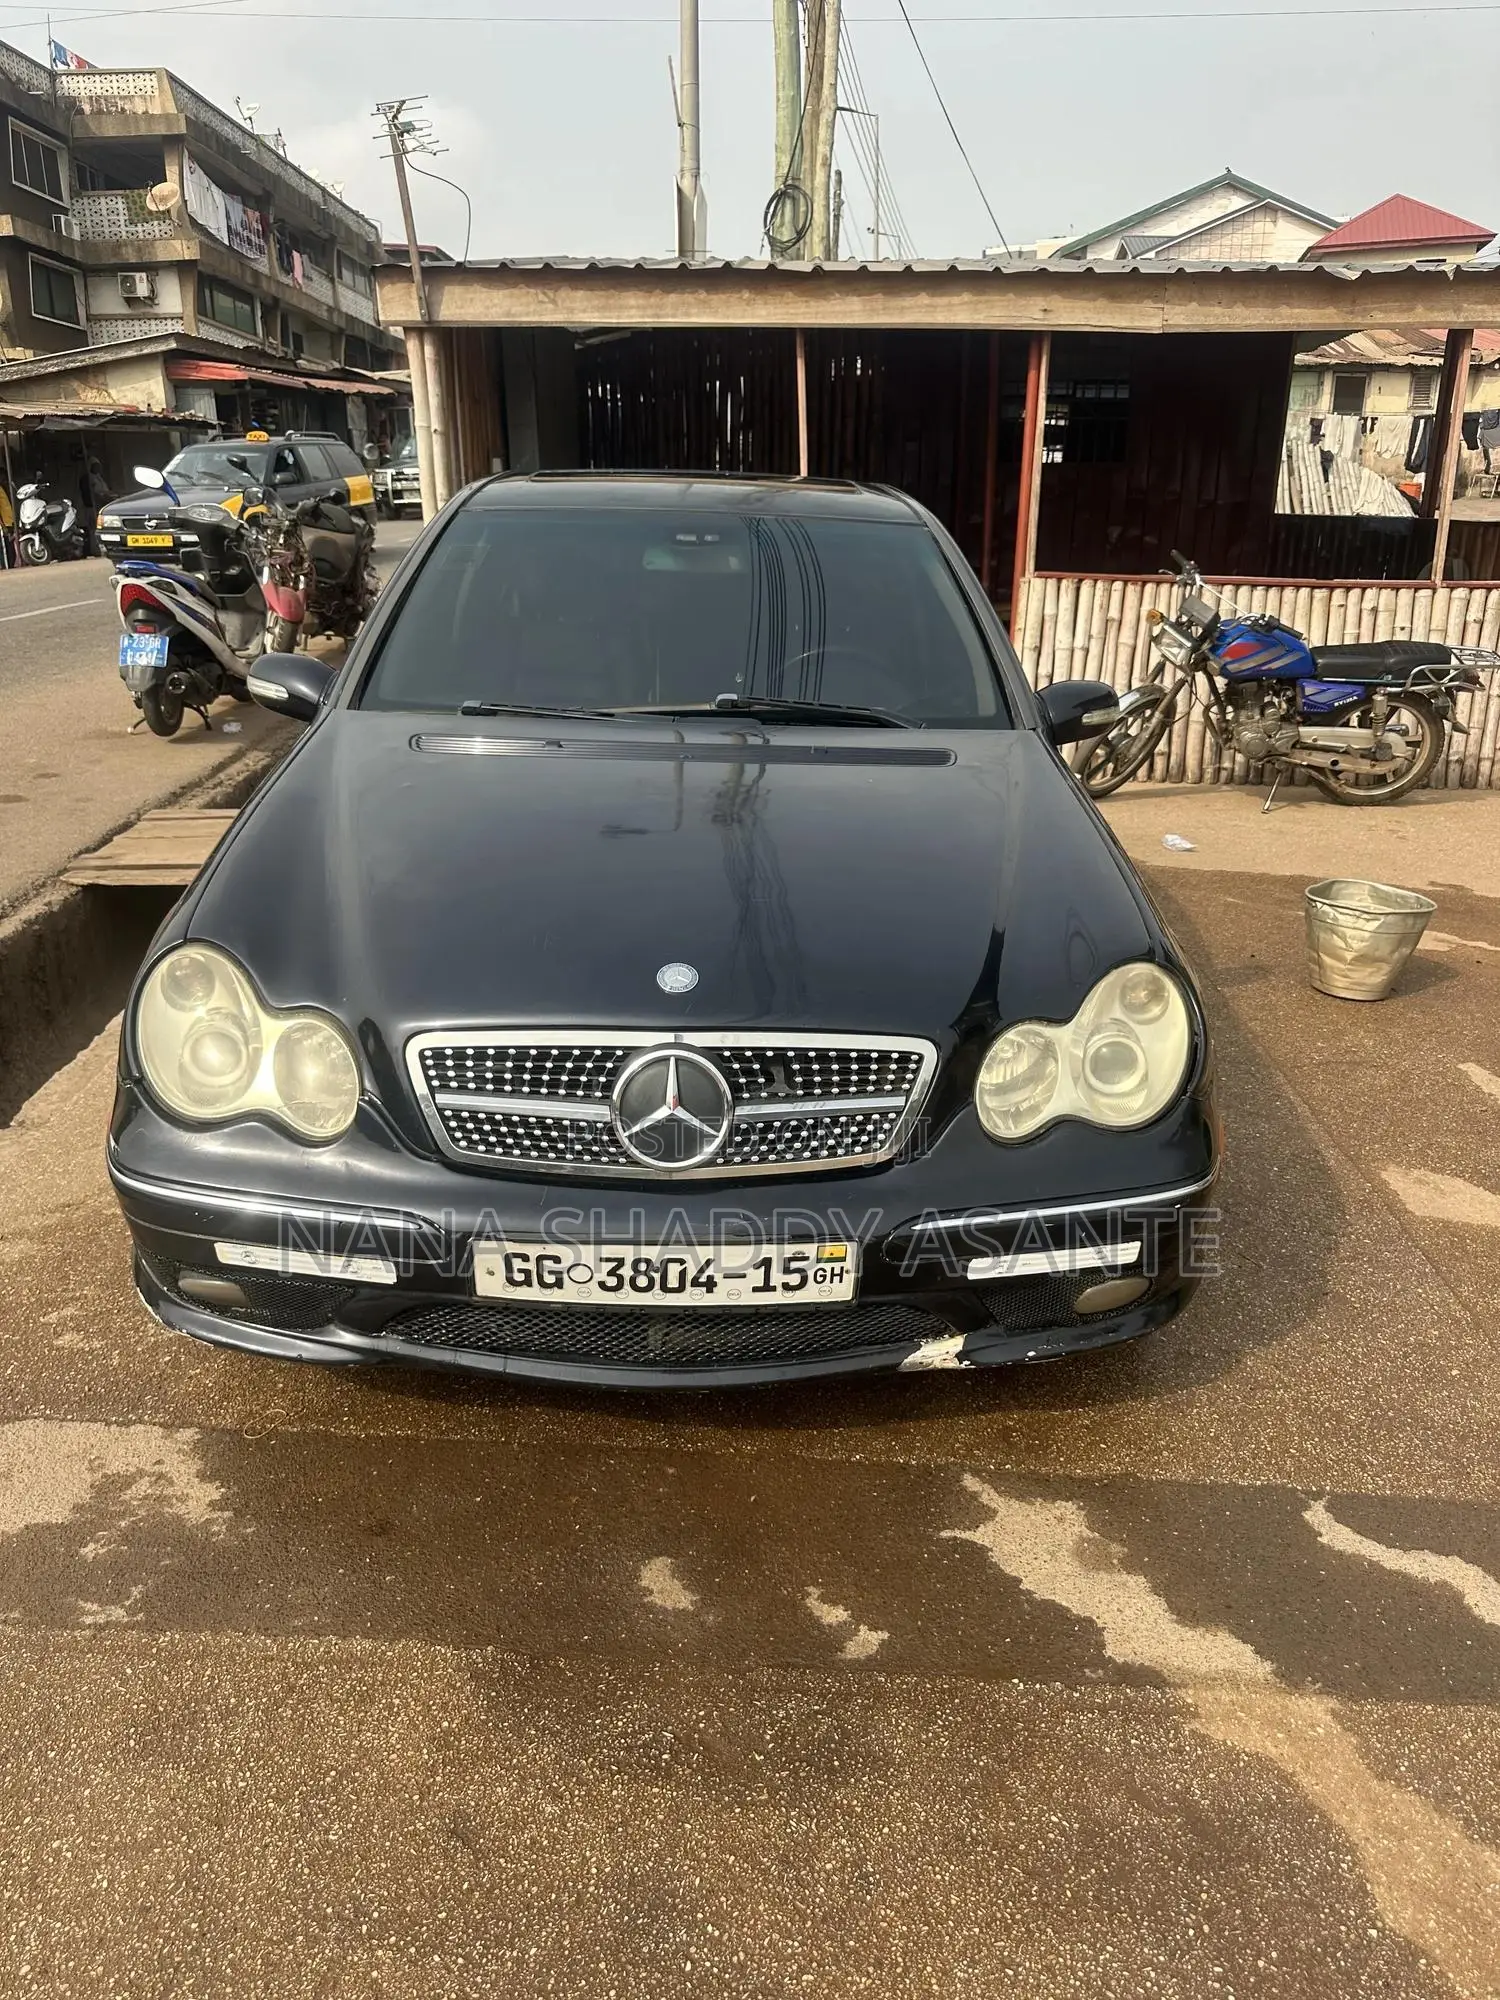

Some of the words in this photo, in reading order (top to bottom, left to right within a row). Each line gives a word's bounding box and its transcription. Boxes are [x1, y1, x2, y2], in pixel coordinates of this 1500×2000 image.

[504, 1252, 565, 1289] GG
[597, 1255, 810, 1294] 3804-15
[813, 1266, 844, 1285] GH
